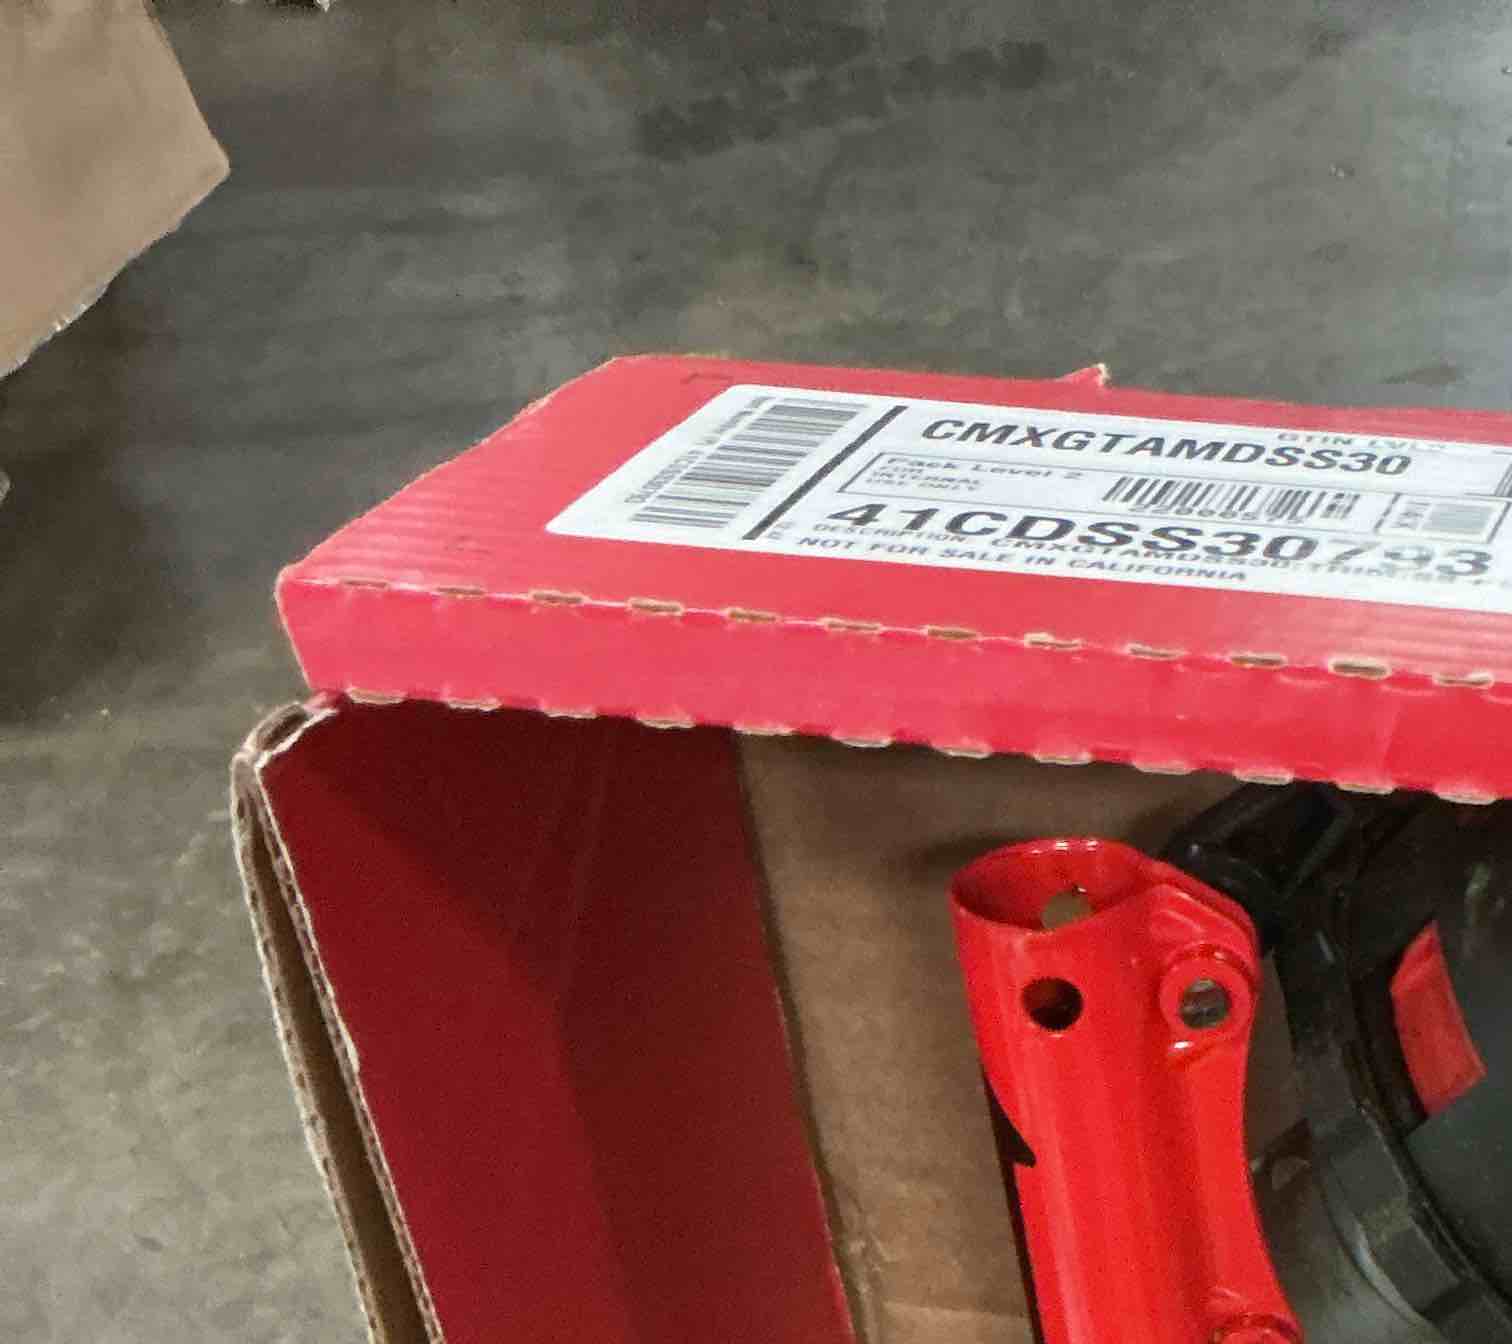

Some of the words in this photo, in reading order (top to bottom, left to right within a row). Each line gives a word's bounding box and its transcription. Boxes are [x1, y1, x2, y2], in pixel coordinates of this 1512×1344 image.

[922, 418, 1412, 476] CMXGTAMDSS30
[971, 463, 1053, 479] Level
[797, 536, 858, 550] NOT
[869, 542, 928, 557] FOR
[939, 548, 1017, 564] SALE
[1024, 555, 1057, 567] IN
[1067, 558, 1247, 582] CALIFORNIA
[826, 503, 1493, 577] 41CDSS30793
